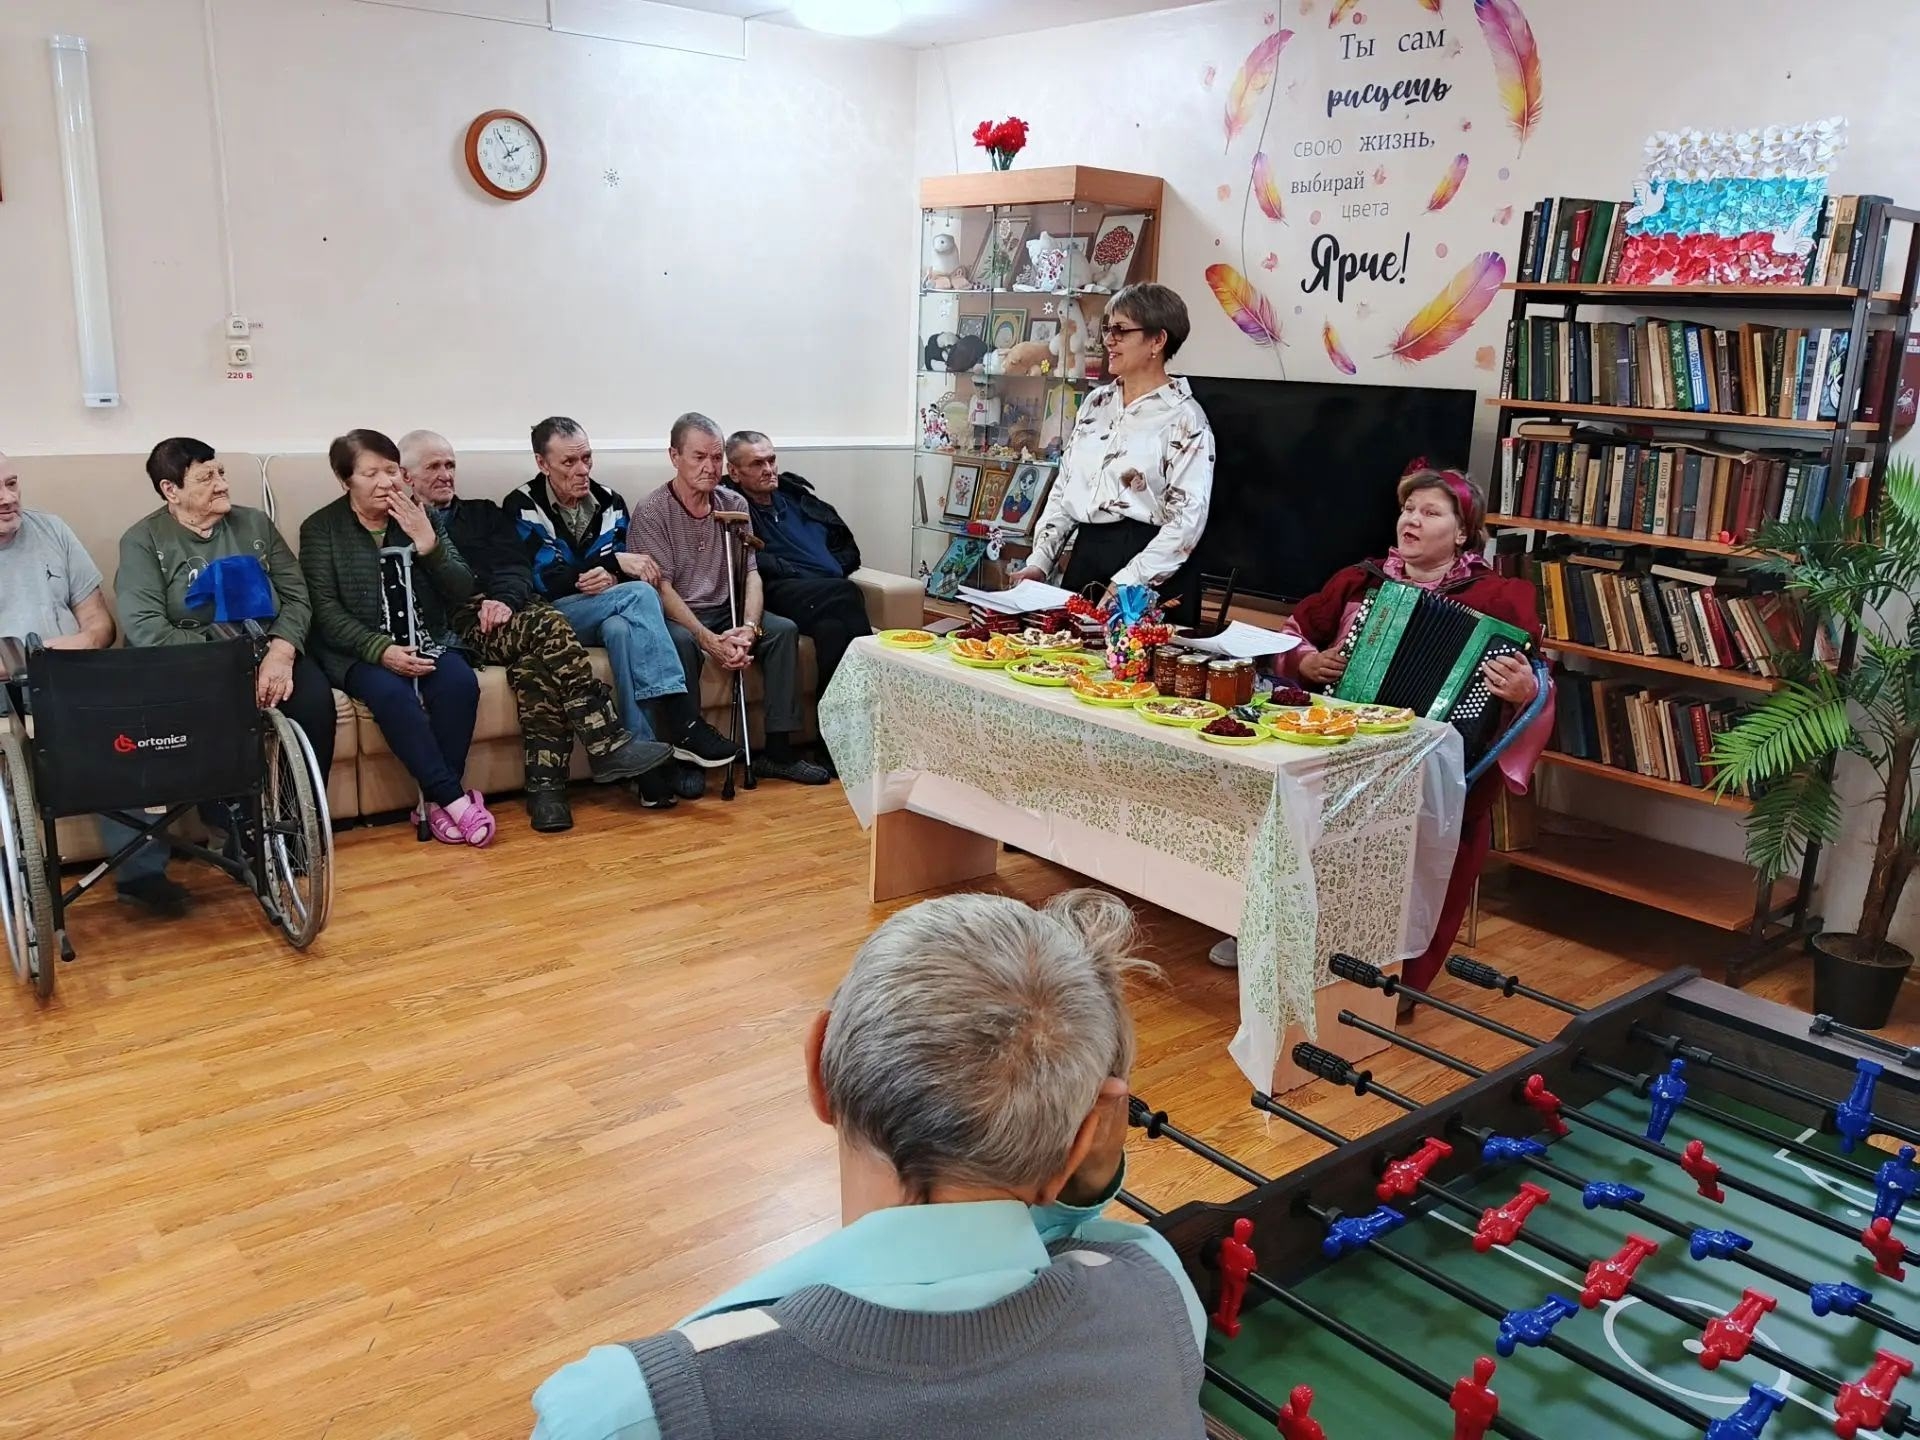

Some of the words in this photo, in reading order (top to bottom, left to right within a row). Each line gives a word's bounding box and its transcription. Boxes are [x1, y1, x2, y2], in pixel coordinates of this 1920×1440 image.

[1340, 32, 1375, 60] Ты
[1398, 29, 1446, 52] сам
[1294, 138, 1342, 158] свою
[1359, 131, 1435, 152] жизнь,
[1291, 171, 1365, 197] выбирай
[1341, 202, 1389, 220] цвета
[1300, 232, 1411, 303] Ярче!
[137, 734, 187, 748] ortonica
